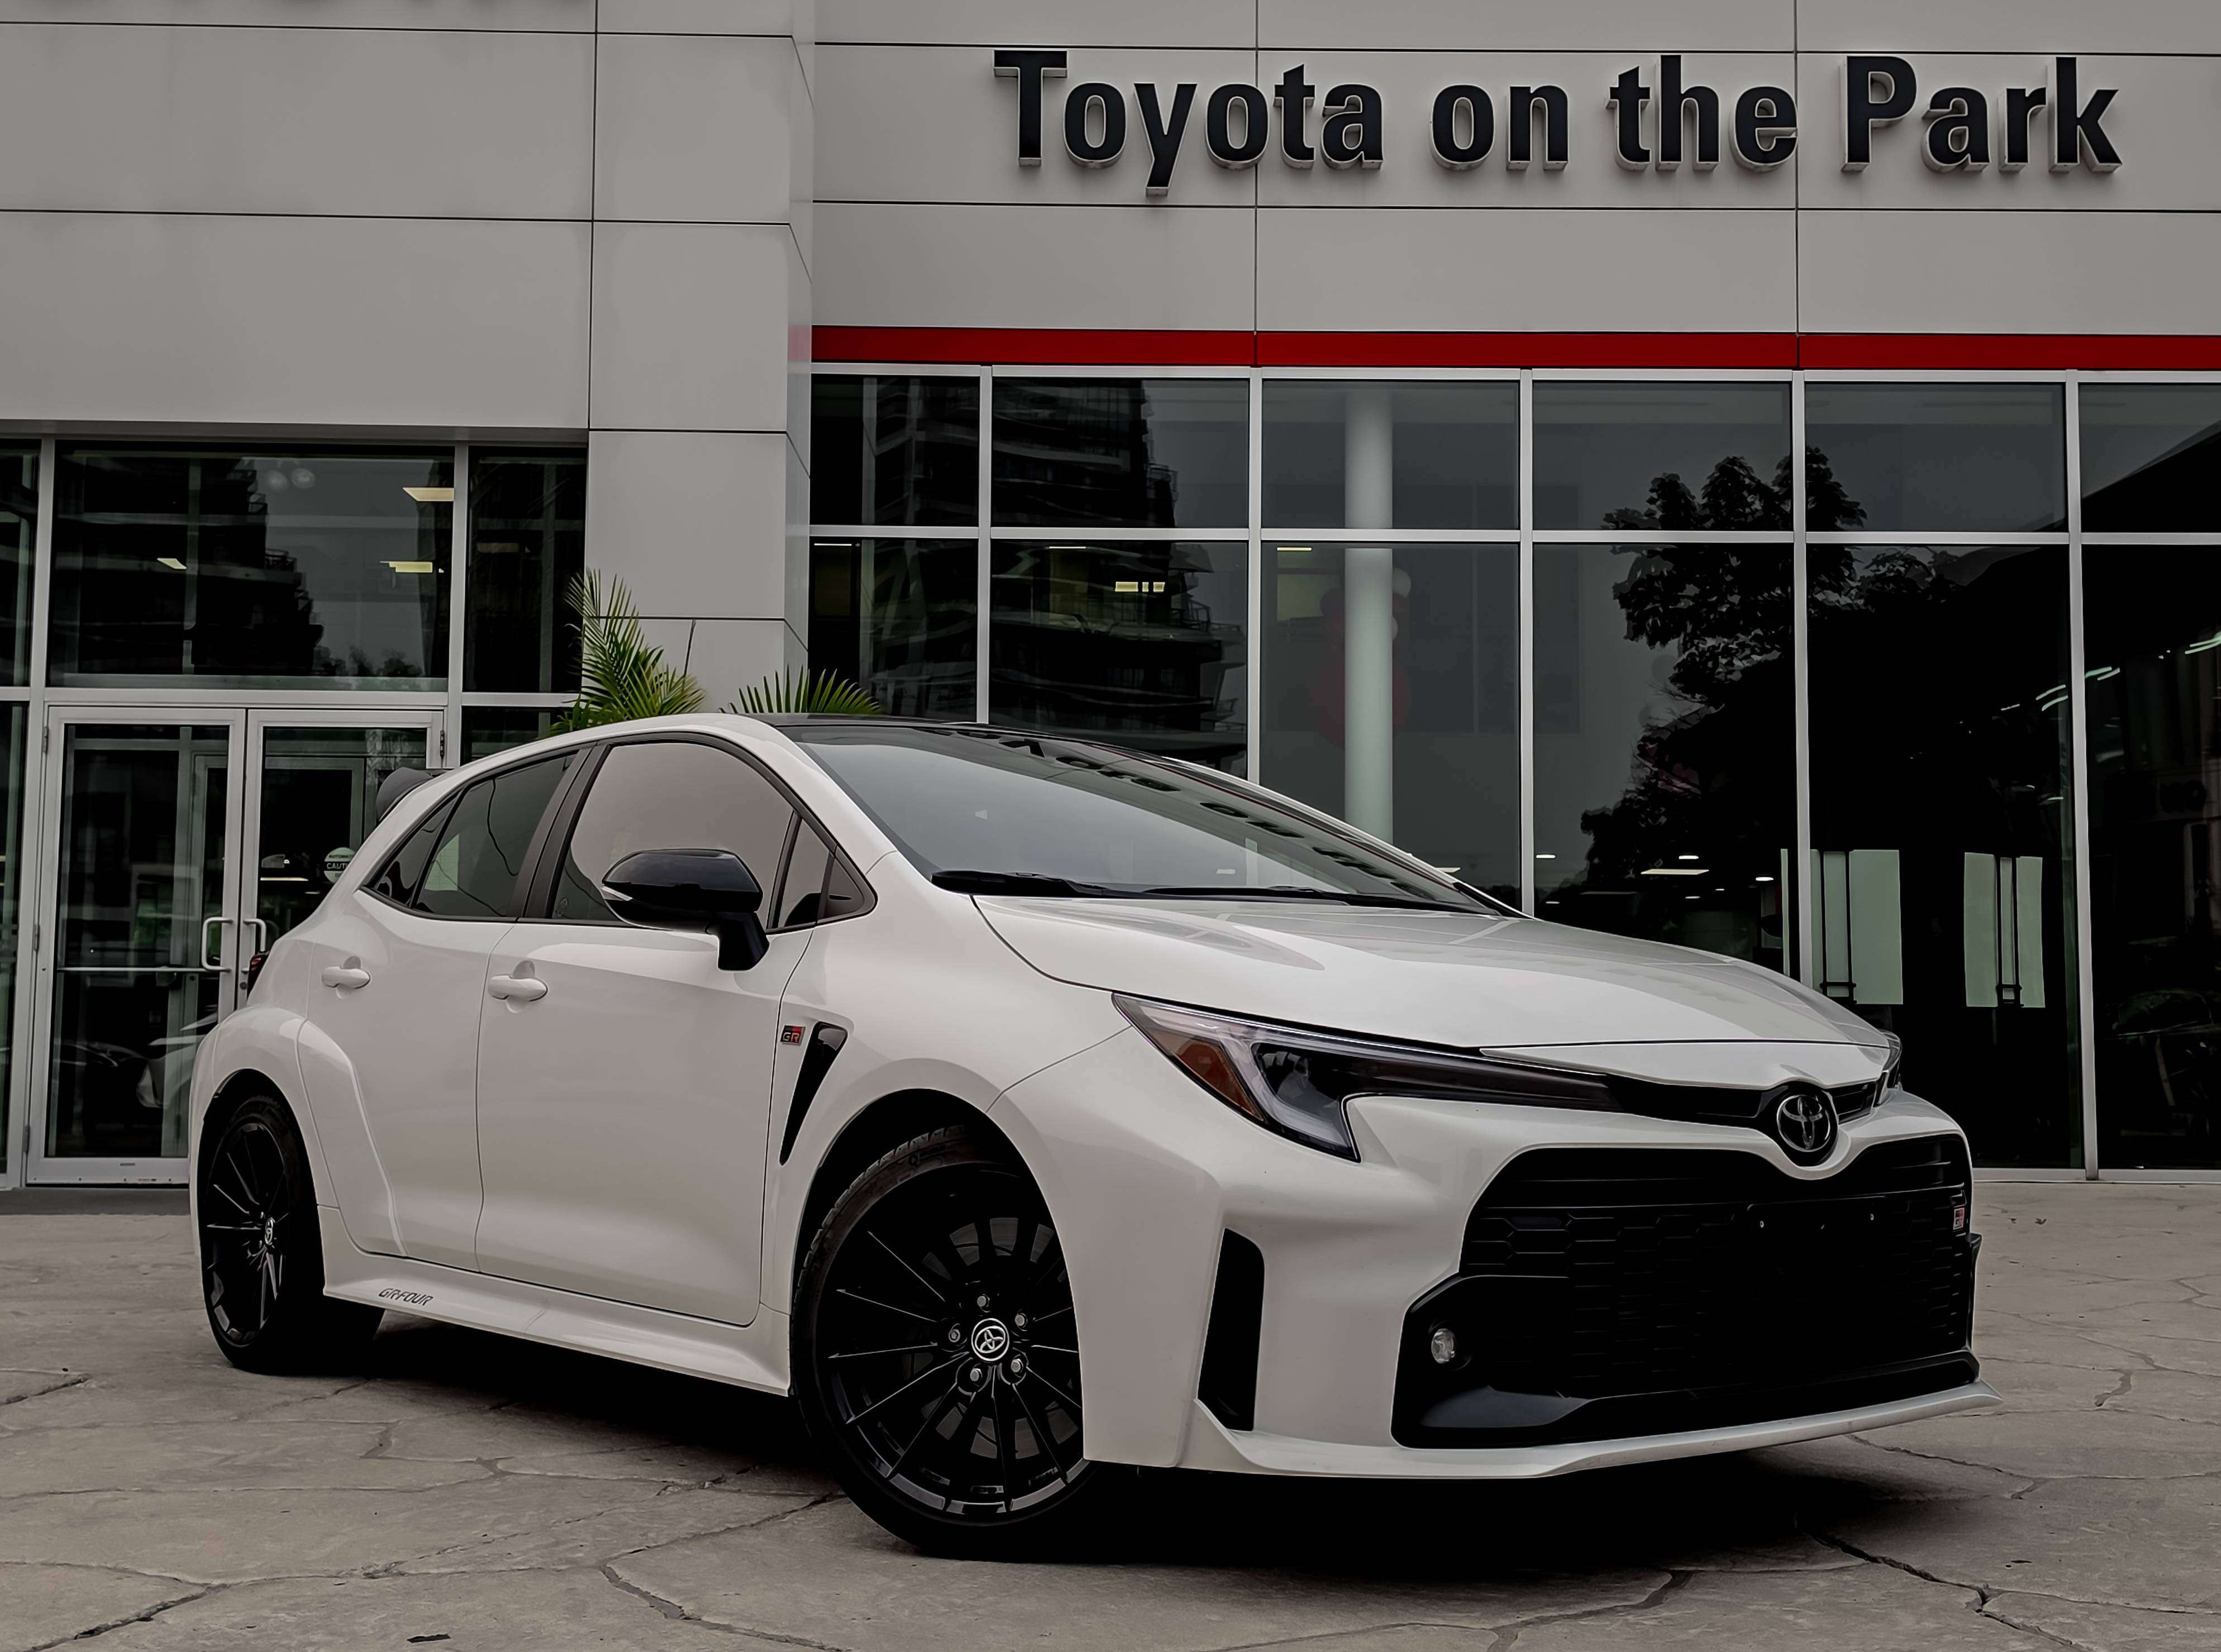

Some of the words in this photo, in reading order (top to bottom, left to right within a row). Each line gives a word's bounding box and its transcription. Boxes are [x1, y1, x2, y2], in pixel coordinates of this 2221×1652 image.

[993, 49, 1384, 194] Toyota
[1430, 84, 1569, 169] on
[1607, 54, 1798, 170] the
[1842, 55, 2123, 171] Park
[782, 1032, 800, 1043] GR
